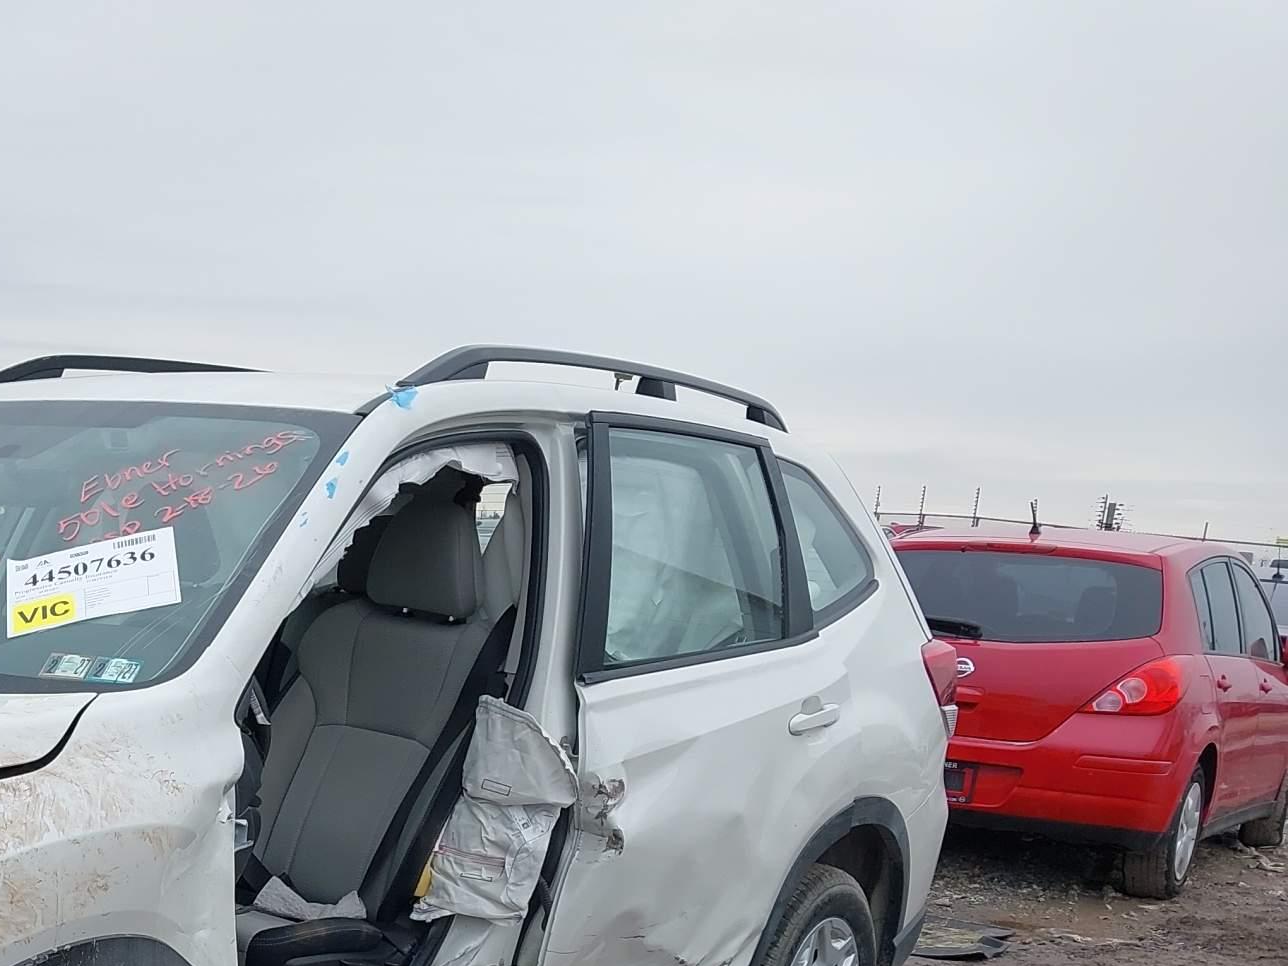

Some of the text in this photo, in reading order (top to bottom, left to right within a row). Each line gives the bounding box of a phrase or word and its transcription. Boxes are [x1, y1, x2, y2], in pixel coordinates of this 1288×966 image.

[80, 448, 181, 503] Ebner
[24, 547, 155, 586] 44507636
[17, 601, 70, 624] VIC
